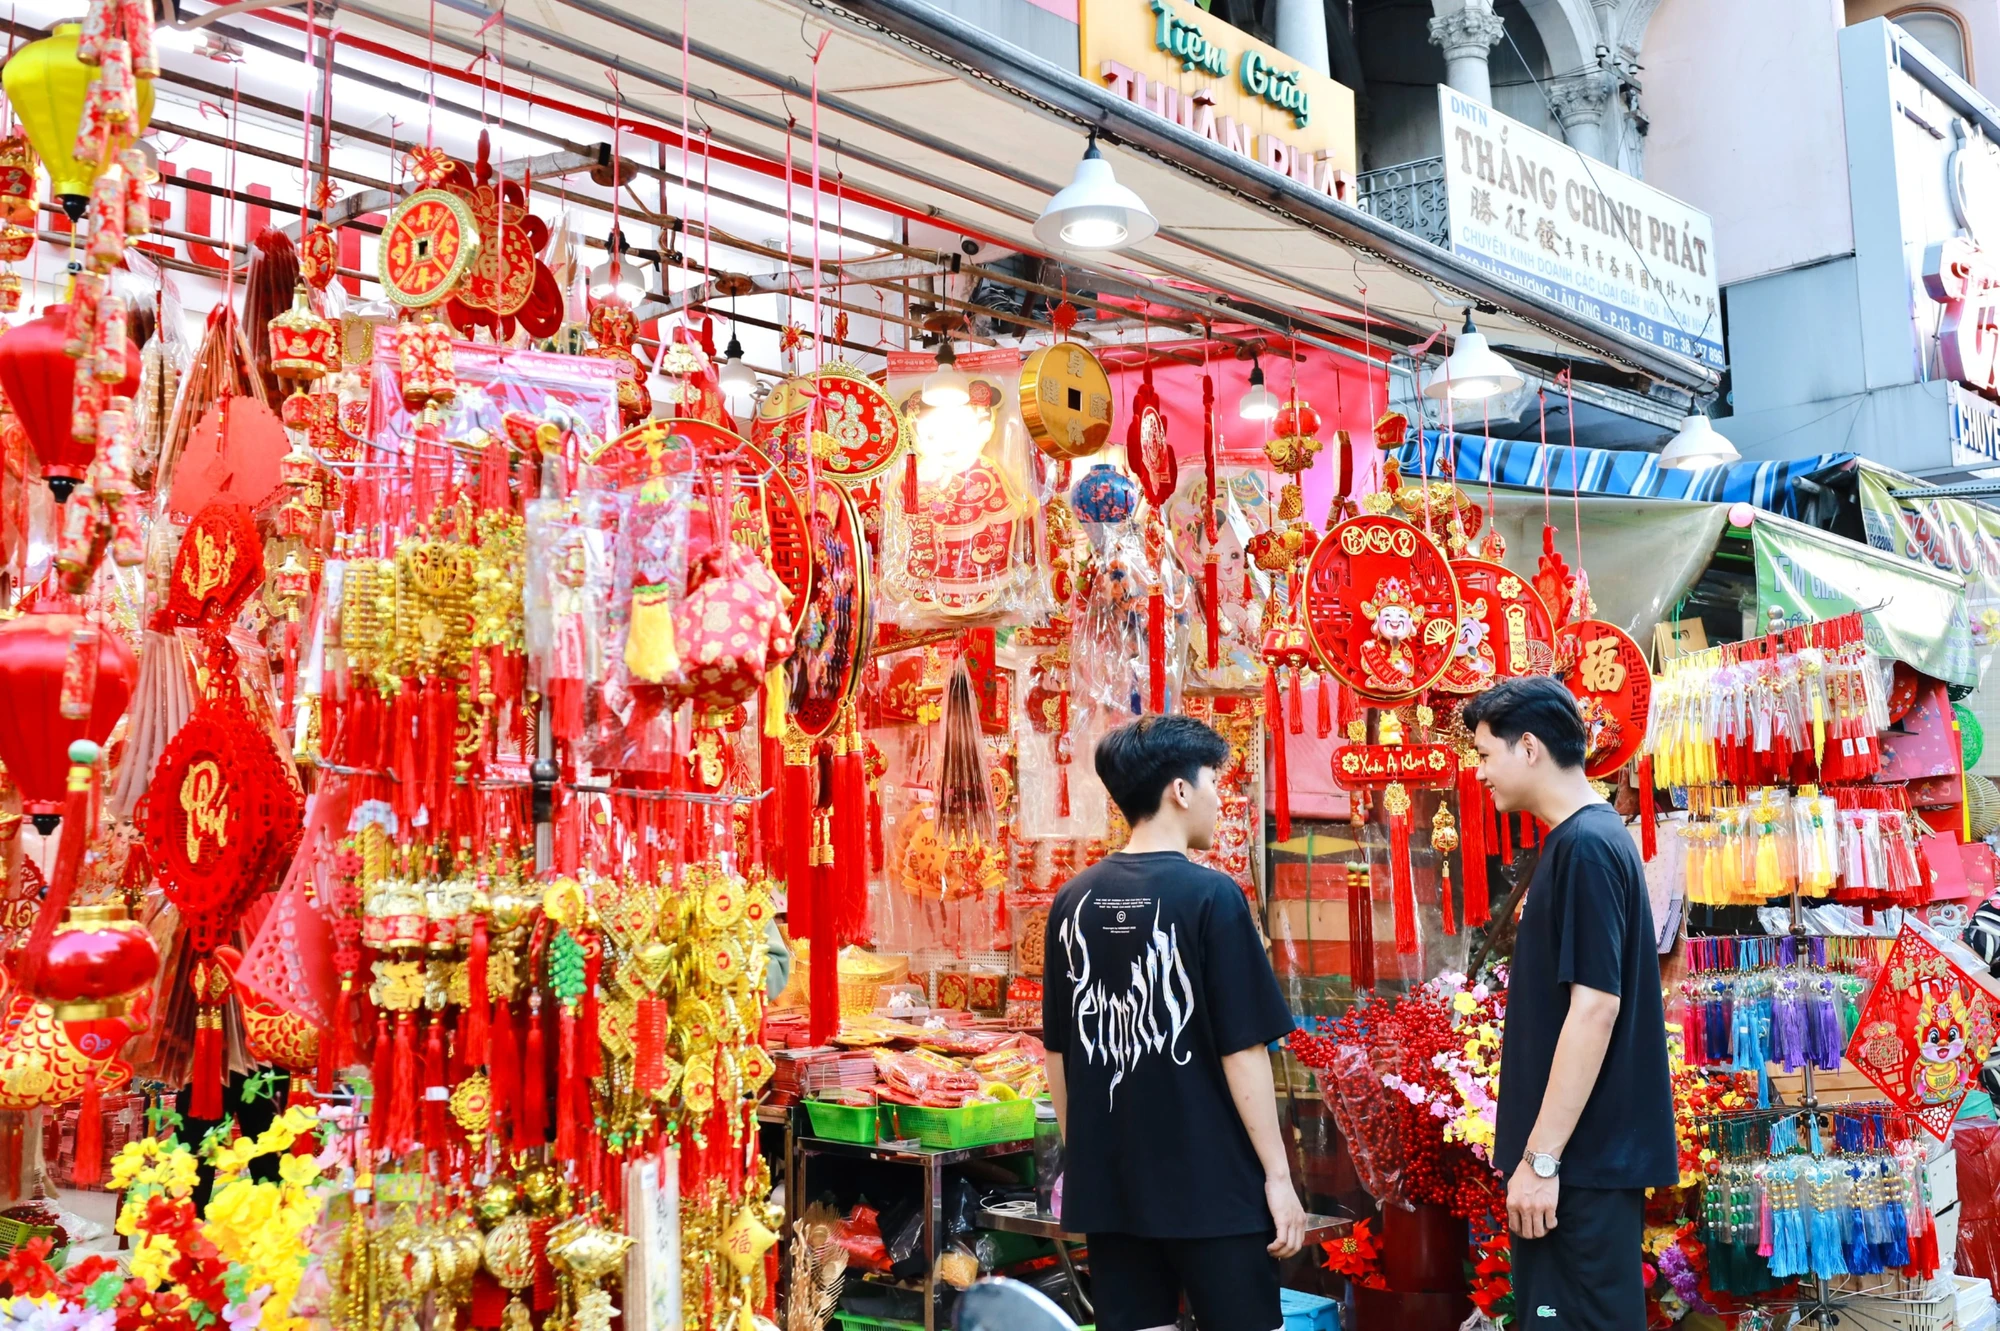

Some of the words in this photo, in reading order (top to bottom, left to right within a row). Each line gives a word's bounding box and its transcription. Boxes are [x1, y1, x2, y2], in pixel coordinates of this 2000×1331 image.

[1150, 0, 1231, 78] Tiệm
[1239, 50, 1312, 129] Giấy
[1451, 95, 1488, 127] DNTN
[1455, 125, 1557, 210] THẮNG
[1565, 178, 1643, 251] CHINH
[1647, 220, 1707, 277] PHÁT
[1462, 226, 1507, 258] CHUYÊN
[1510, 245, 1534, 270] KINH
[1537, 257, 1573, 284] DOANH
[1575, 271, 1595, 292] CÁC
[1597, 280, 1618, 302] LOẠI
[1620, 288, 1641, 309] GIẤY
[1577, 294, 1600, 321] ÔNG
[1610, 311, 1630, 333] P.13
[1638, 322, 1654, 341] Q.5
[1580, 635, 1626, 692] 福
[728, 1226, 752, 1256] 福
